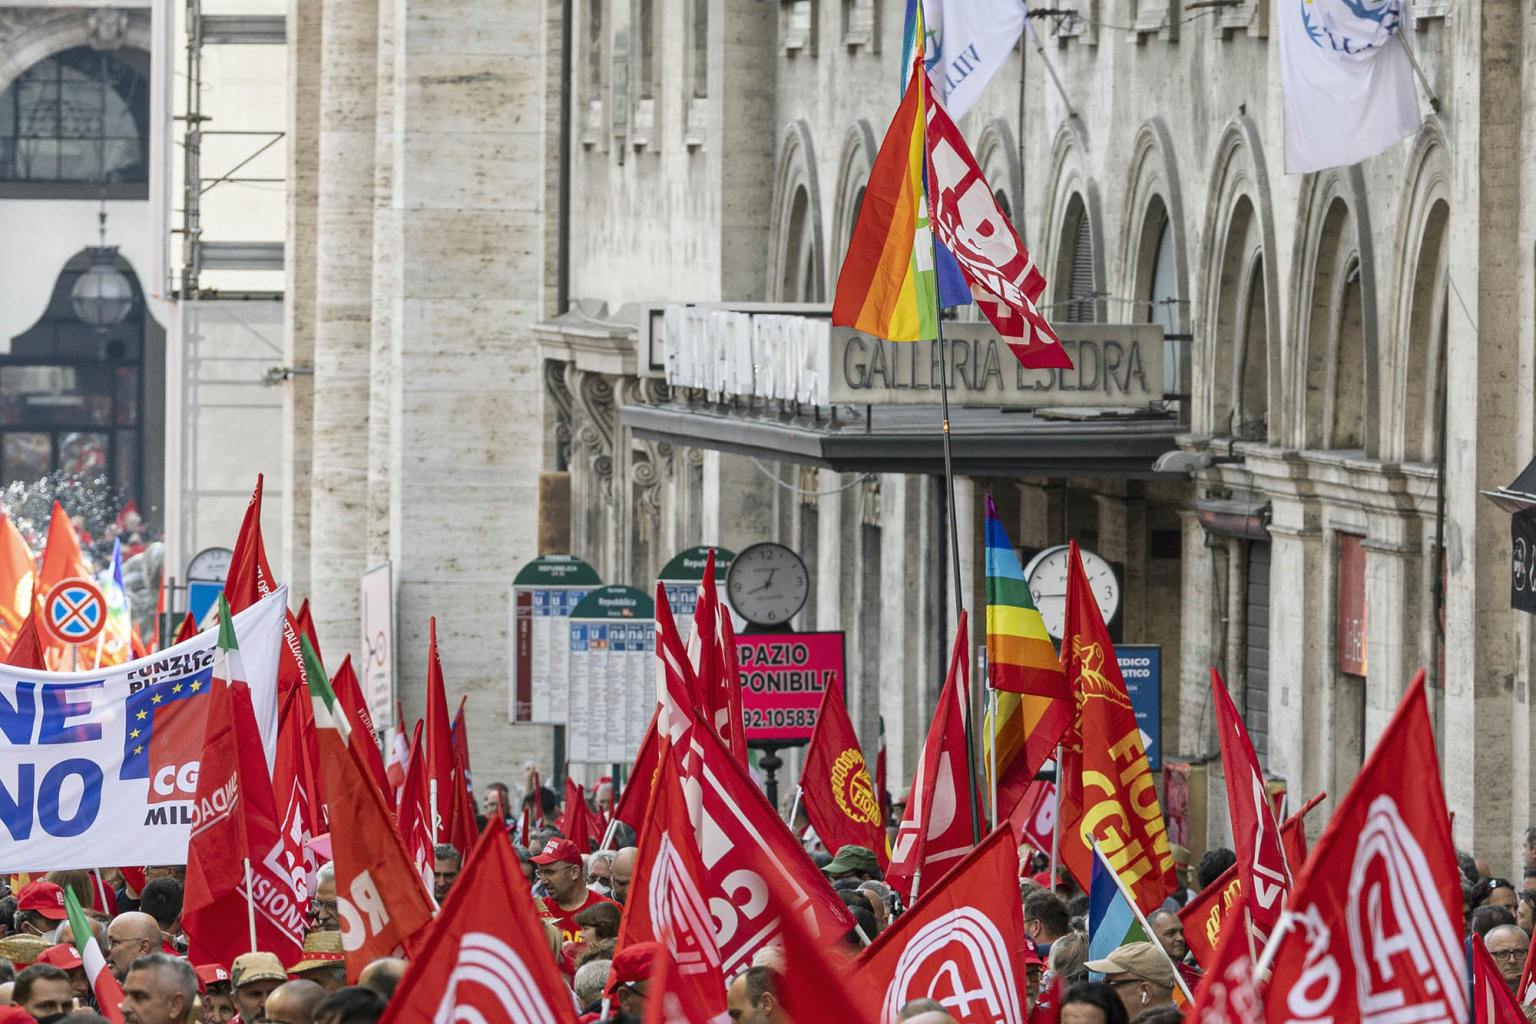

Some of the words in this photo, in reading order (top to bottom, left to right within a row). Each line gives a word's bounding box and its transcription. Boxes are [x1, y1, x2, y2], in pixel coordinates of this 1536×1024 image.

[843, 335, 1005, 392] GALLERIA
[683, 558, 725, 568] Repubica
[760, 551, 774, 560] 12
[734, 582, 742, 592] 9
[796, 577, 804, 587] 3
[1032, 589, 1042, 603] 9
[1103, 585, 1114, 601] 3
[767, 609, 776, 621] 6
[127, 645, 218, 681] FUNZIO
[1116, 657, 1151, 667] EDICO
[739, 669, 837, 693] PONIBILE
[153, 761, 201, 796] CG
[852, 788, 881, 826] FIOM
[144, 805, 192, 827] MIL
[1079, 769, 1153, 901] CGIL
